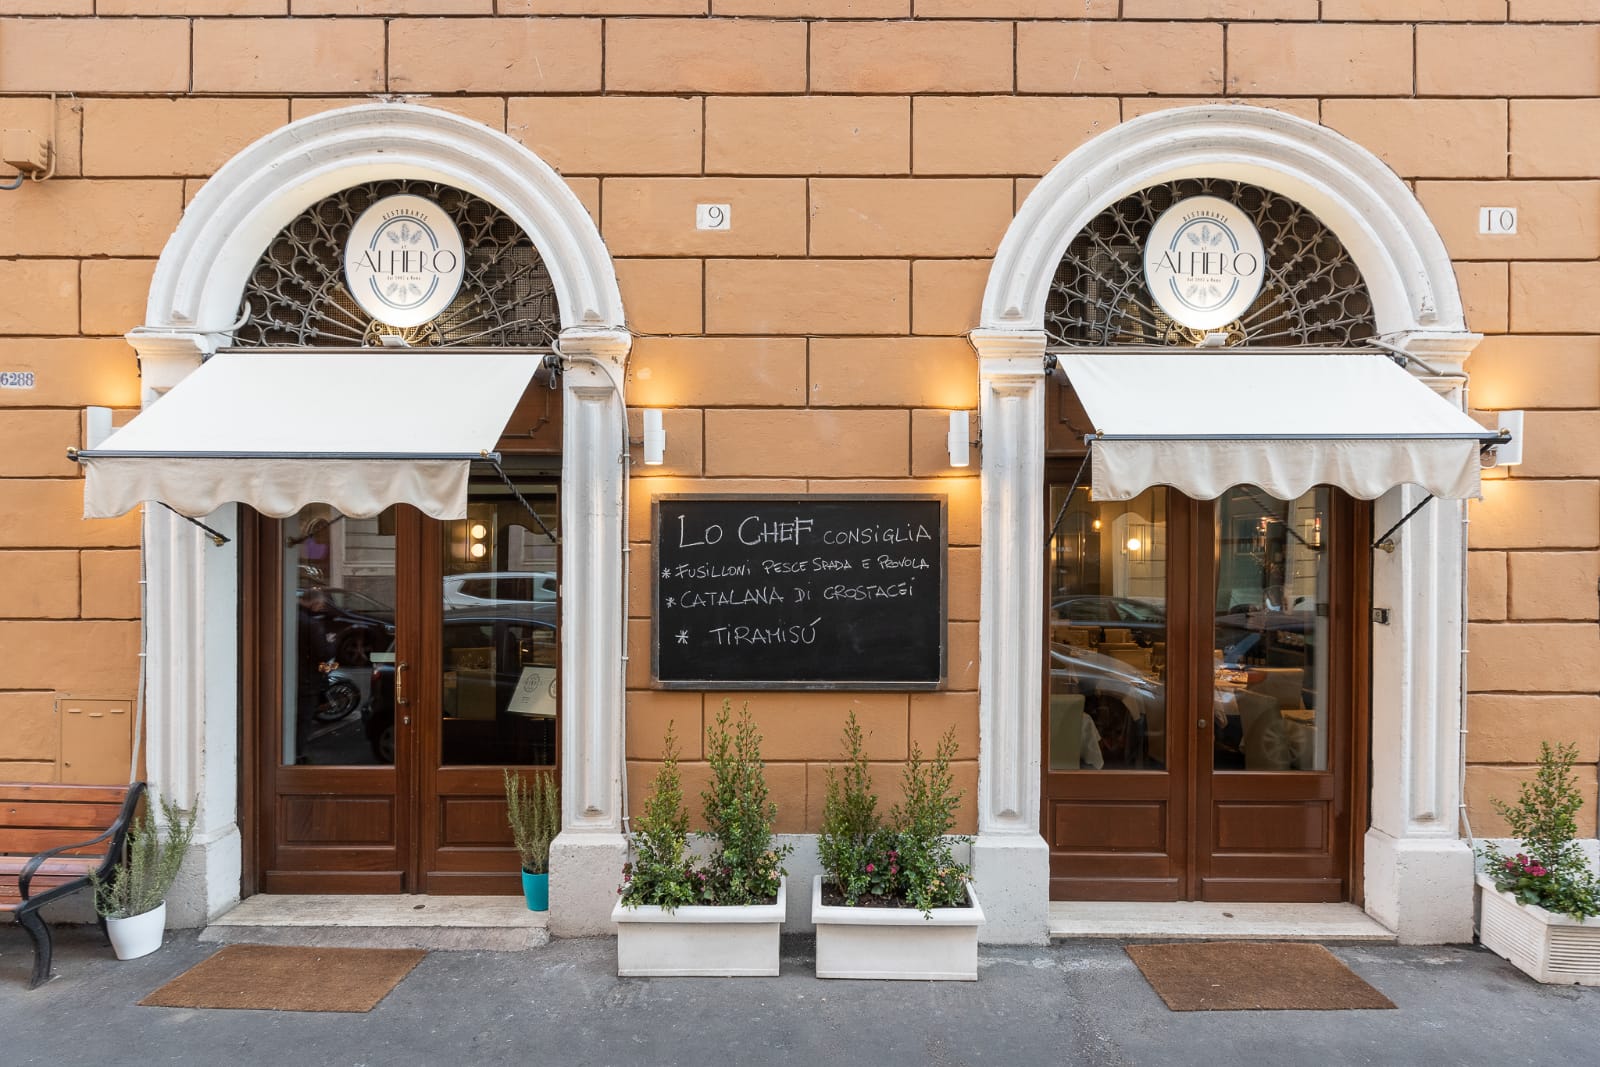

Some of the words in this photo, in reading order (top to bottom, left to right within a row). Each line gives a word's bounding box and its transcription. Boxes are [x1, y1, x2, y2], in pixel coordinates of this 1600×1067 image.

[708, 206, 724, 228] 9
[1487, 209, 1514, 231] 10
[352, 249, 457, 275] ALFIERO
[1152, 251, 1257, 277] ALFIERO
[0, 372, 34, 387] 6288
[738, 515, 814, 546] CHEF
[762, 559, 809, 575] PESCE
[812, 557, 853, 572] SPADA
[861, 558, 871, 569] E
[680, 586, 785, 608] CATALANA
